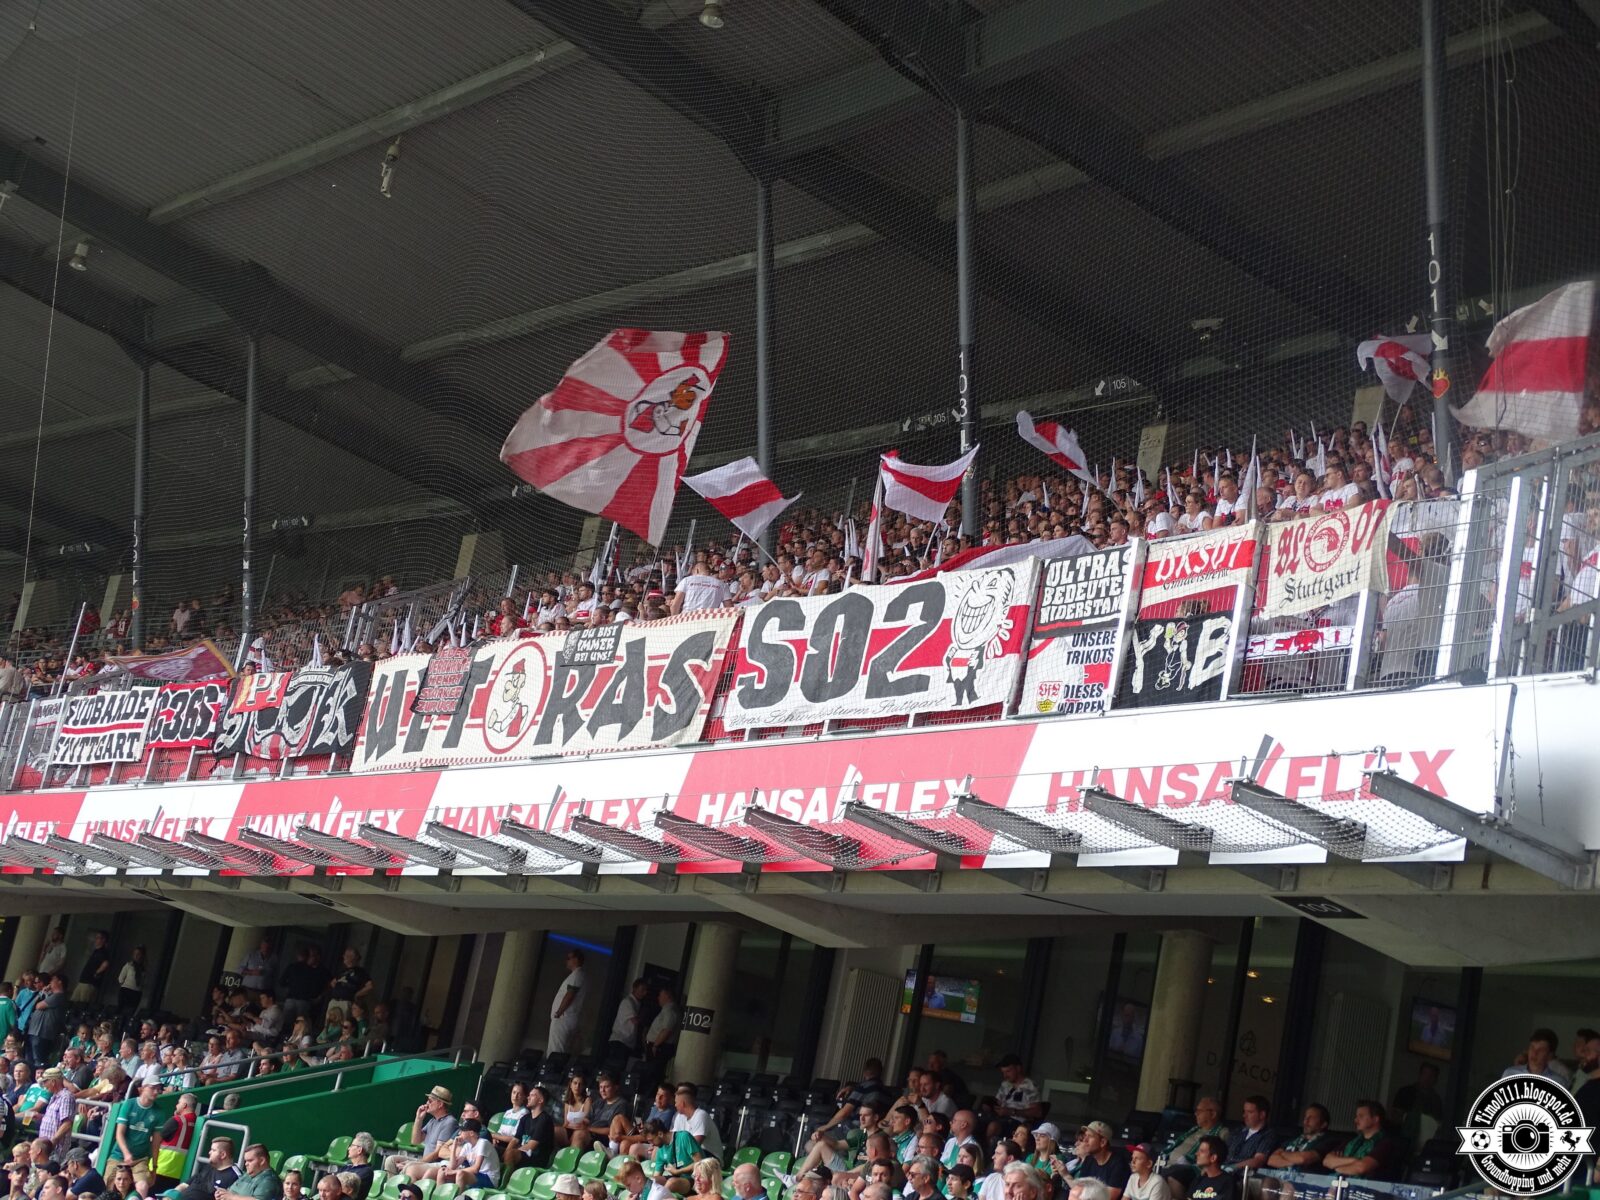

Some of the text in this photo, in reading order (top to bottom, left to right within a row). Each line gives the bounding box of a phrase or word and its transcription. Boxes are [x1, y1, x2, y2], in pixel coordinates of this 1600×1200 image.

[1427, 231, 1441, 313] 101
[958, 351, 968, 418] 103
[1045, 548, 1131, 587] ULTRAS
[1042, 575, 1125, 607] BEDEUTE
[1279, 561, 1362, 608] Stuttgart
[1040, 595, 1122, 624] WIDERSTAN
[581, 625, 619, 639] DU BIST
[1072, 630, 1117, 647] UNSERE
[577, 637, 615, 652] IMMER
[573, 650, 613, 662] BEI UNS!
[1066, 648, 1115, 665] TRIKOTS
[1063, 683, 1104, 700] DIESES
[1058, 700, 1105, 714] WAPPEN
[224, 975, 241, 988] 104
[688, 1012, 711, 1028] 102
